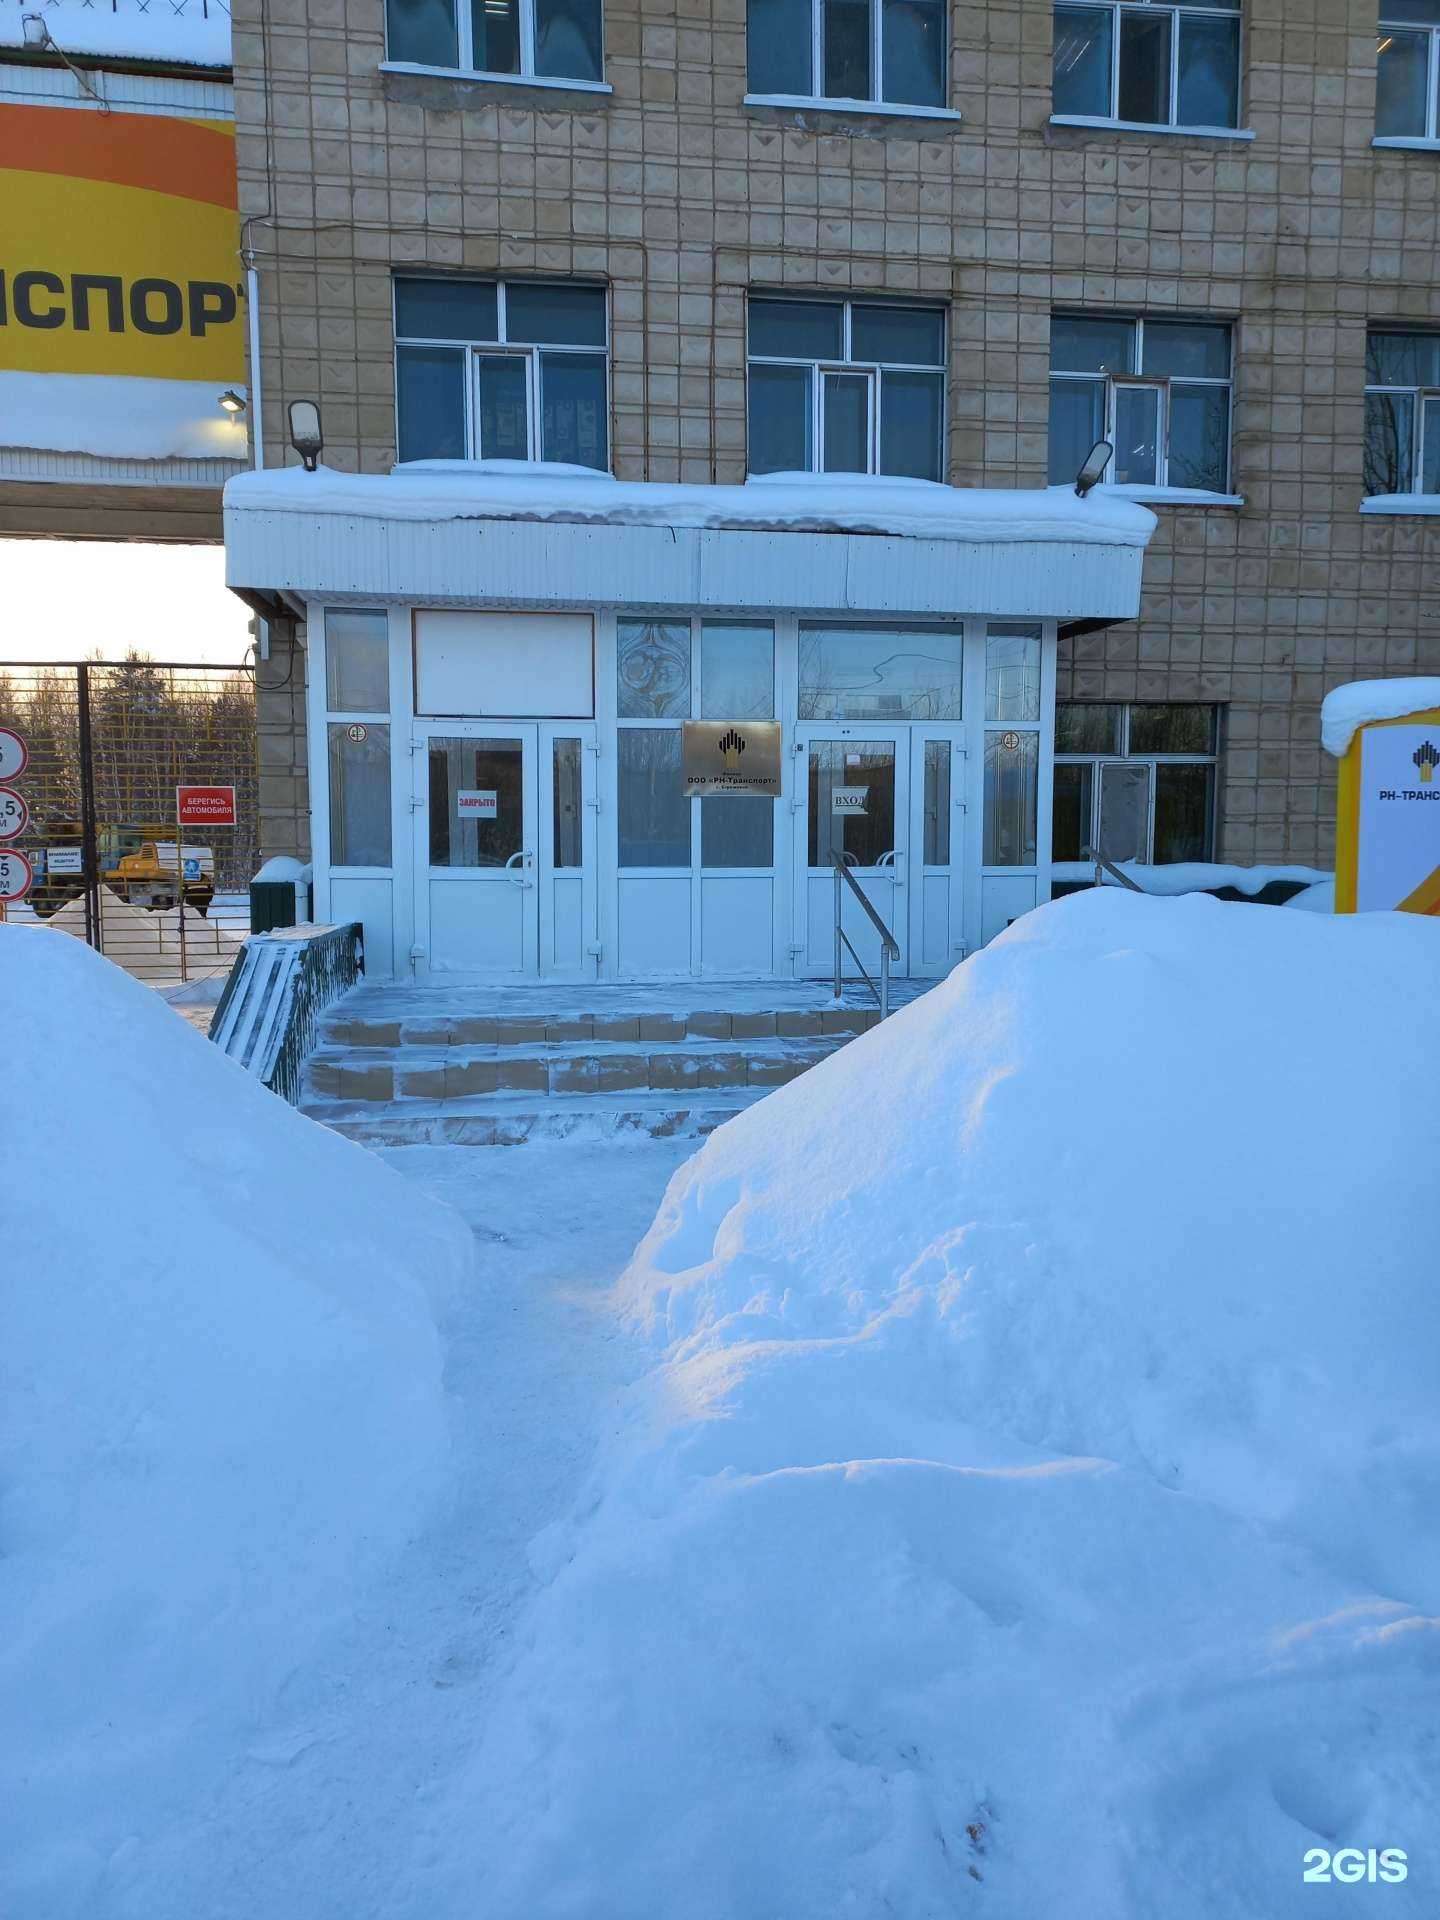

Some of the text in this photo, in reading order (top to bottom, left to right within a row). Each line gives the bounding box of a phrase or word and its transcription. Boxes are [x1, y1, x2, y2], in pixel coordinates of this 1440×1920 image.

[0, 269, 244, 337] СПОР
[687, 776, 706, 785] ООО
[187, 797, 226, 805] БЕРЕГИСЬ
[459, 798, 496, 807] ЗАКРЫТО
[182, 806, 232, 814] АВТОМОБИЛЯ
